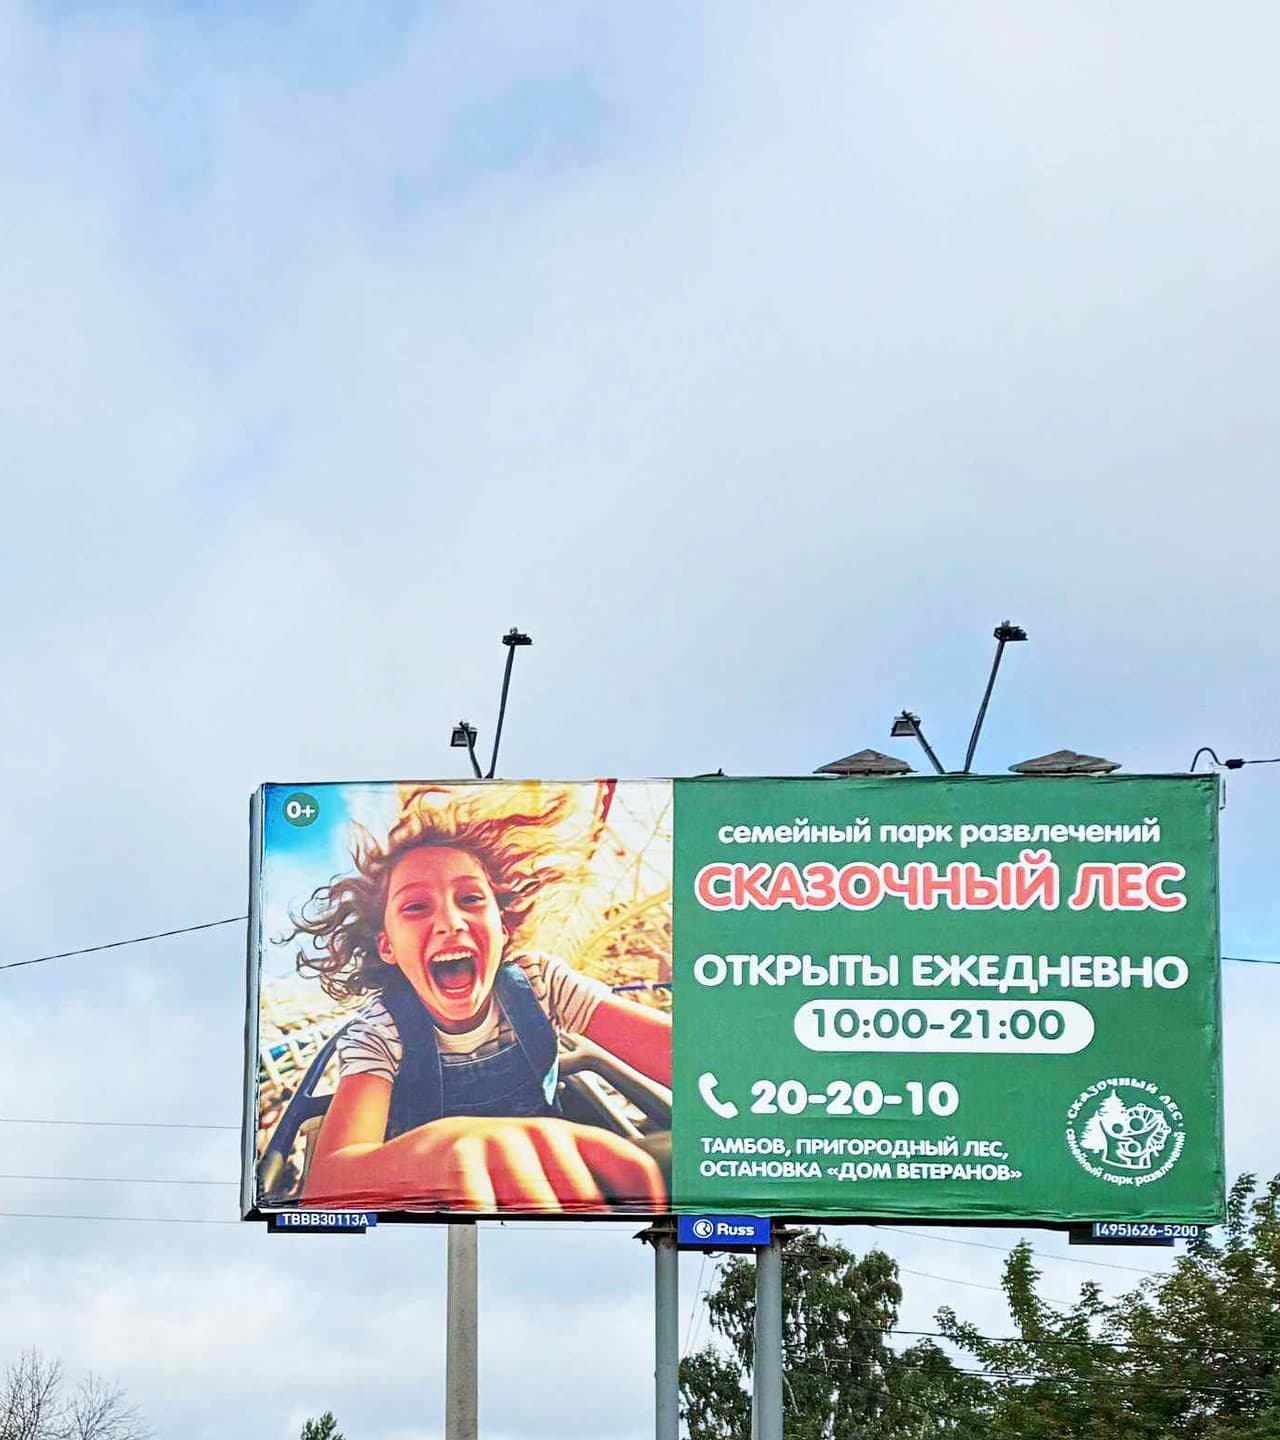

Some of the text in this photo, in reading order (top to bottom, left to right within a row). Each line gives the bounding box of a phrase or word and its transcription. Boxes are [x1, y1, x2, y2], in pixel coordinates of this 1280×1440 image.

[286, 800, 316, 819] 0+
[718, 817, 1161, 849] семейный парк развлечений
[695, 848, 1187, 912] СКАЗОЧНЫЙ ЛЕС
[693, 953, 1190, 995] ОТКРЫТЫ ЕЖЕДНЕВНО
[812, 1007, 1066, 1041] 10:00-21:00
[750, 1079, 960, 1117] 20-20-10
[701, 1135, 1009, 1161] ТАМБОВ, ПРИГОРОДНЫЙ ЛЕС,
[699, 1160, 1023, 1182] ОСТАНОВКА «ДОМ ВЕТЕРАНОВ»
[716, 1222, 755, 1237] Russ
[1095, 1222, 1199, 1238] (495)626-5200
